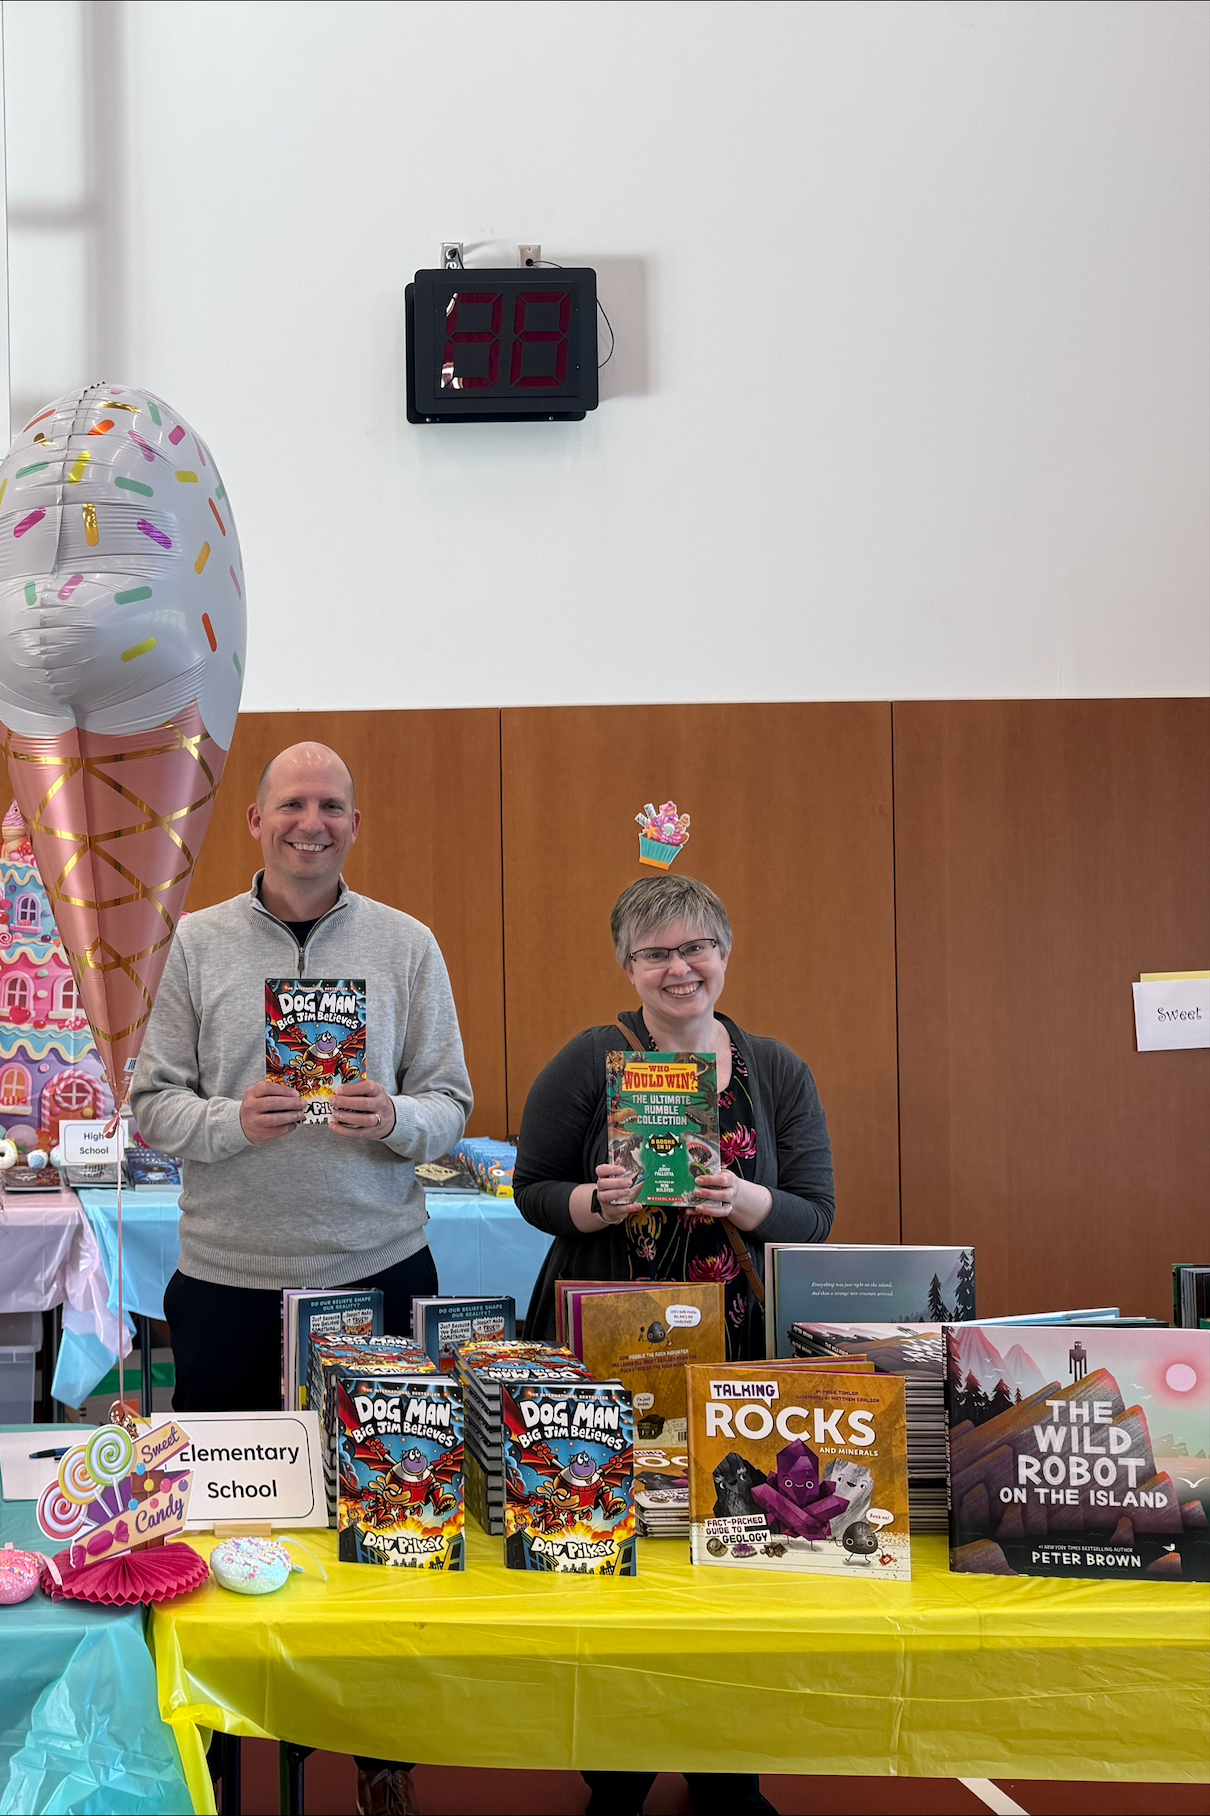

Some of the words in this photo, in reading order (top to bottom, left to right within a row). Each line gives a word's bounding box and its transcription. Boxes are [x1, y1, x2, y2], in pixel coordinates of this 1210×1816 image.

[278, 993, 316, 1015] DOG
[319, 993, 356, 1014] MAN
[1157, 1006, 1202, 1023] Sweet
[624, 1071, 663, 1090] WOULD
[665, 1070, 699, 1090] WIN?
[632, 1094, 648, 1104] THE
[650, 1095, 691, 1105] ULTIMATE
[644, 1105, 679, 1115] RUMBLE
[637, 1115, 687, 1125] COLLECTION
[83, 1132, 104, 1142] High
[79, 1146, 109, 1155] School
[811, 1281, 835, 1289] Everything
[335, 1302, 360, 1310] REALITY?
[369, 1337, 408, 1346] MAN
[666, 1348, 689, 1356] REPORTER
[713, 1384, 776, 1397] TALKING
[354, 1395, 401, 1423] DOG
[405, 1398, 451, 1427] MAN
[519, 1400, 568, 1428] DOG
[572, 1402, 620, 1430] MAN
[1045, 1399, 1114, 1424] THE
[705, 1402, 877, 1447] ROCKS
[141, 1426, 180, 1464] Sweet
[1033, 1425, 1132, 1455] WILD
[180, 1444, 300, 1465] Elementary
[820, 1447, 837, 1455] AND
[838, 1447, 879, 1457] MINERALS
[1017, 1454, 1146, 1488] ROBOT
[207, 1479, 278, 1499] School
[999, 1487, 1027, 1504] ON
[1034, 1488, 1080, 1505] THE
[1090, 1489, 1168, 1509] ISLAND
[135, 1493, 185, 1533] Candy
[707, 1516, 764, 1527] FACT-PACKED
[706, 1526, 730, 1535] GUIDE
[722, 1532, 768, 1544] GEOLOGY
[362, 1531, 397, 1551] DAV
[531, 1536, 565, 1556] DAV
[1032, 1551, 1082, 1565] PETER
[1086, 1553, 1142, 1567] BROWN
